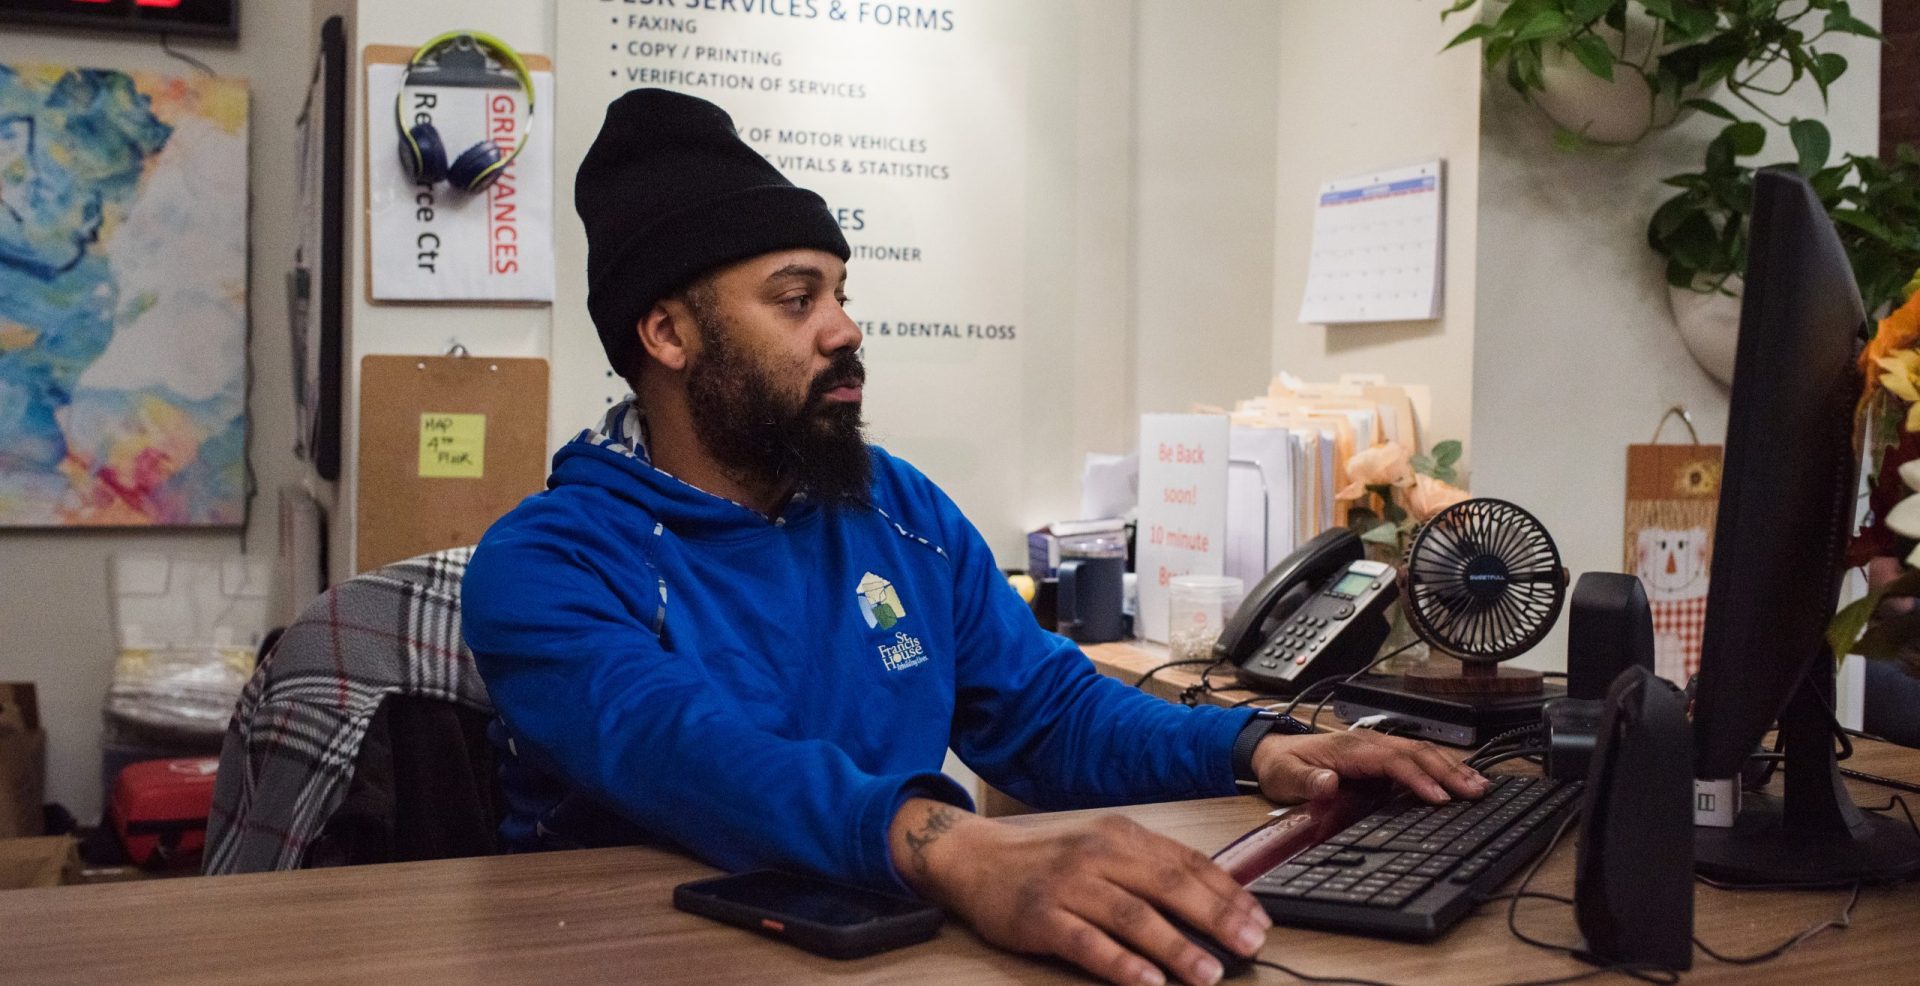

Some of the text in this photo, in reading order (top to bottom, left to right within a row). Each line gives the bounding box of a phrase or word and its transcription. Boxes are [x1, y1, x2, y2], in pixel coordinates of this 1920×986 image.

[627, 14, 698, 34] FAXING
[829, 0, 847, 21] &
[859, 2, 955, 32] FORMS
[627, 40, 678, 59] COPY
[695, 45, 783, 67] PRINTING
[626, 66, 867, 99] VERIFICATION OF SERVICES
[749, 127, 928, 153] OF MOTOR VEHICLES
[777, 154, 836, 173] VITALS
[841, 159, 854, 174] &
[859, 160, 950, 180] STATISTICS
[414, 92, 441, 274] Rerce Ctr
[879, 321, 892, 336] &
[897, 321, 962, 339] DENTAL
[967, 324, 1017, 341] FLOSS
[425, 417, 454, 433] MAP
[1159, 442, 1205, 464] Be Back
[1163, 484, 1197, 505] soon!
[1150, 525, 1210, 552] 10 minute
[878, 636, 920, 659] Francis
[882, 645, 924, 671] House
